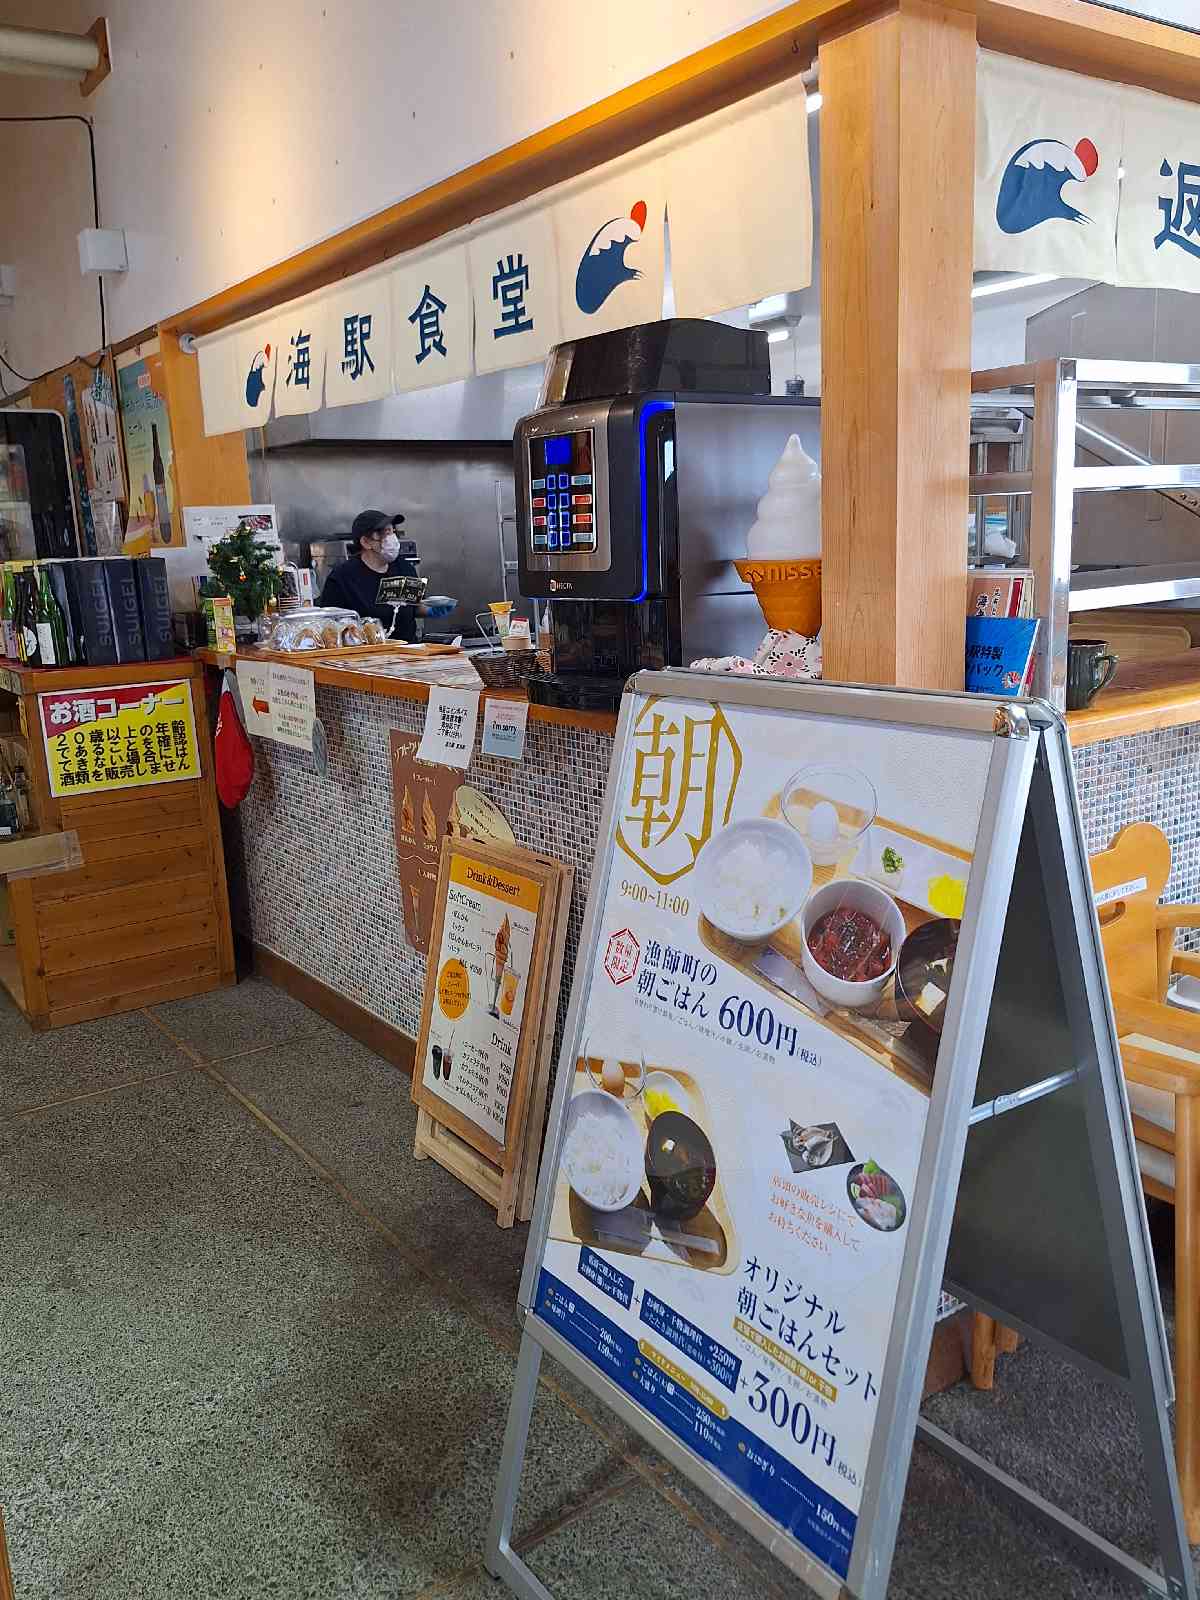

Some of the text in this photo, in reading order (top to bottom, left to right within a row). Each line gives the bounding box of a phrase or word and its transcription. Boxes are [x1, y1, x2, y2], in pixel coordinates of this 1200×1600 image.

[50, 692, 185, 726] お酒コーナー
[60, 761, 191, 787] 酒類を販売しません
[626, 713, 719, 857] 朝
[467, 867, 520, 896] Drink&Dessert
[643, 938, 718, 987] 漁師町の
[637, 967, 709, 1020] 朝ごはん
[490, 1031, 513, 1056] Drink
[744, 1254, 846, 1336] オリジナル
[735, 1285, 879, 1401] 朝ごはんセット
